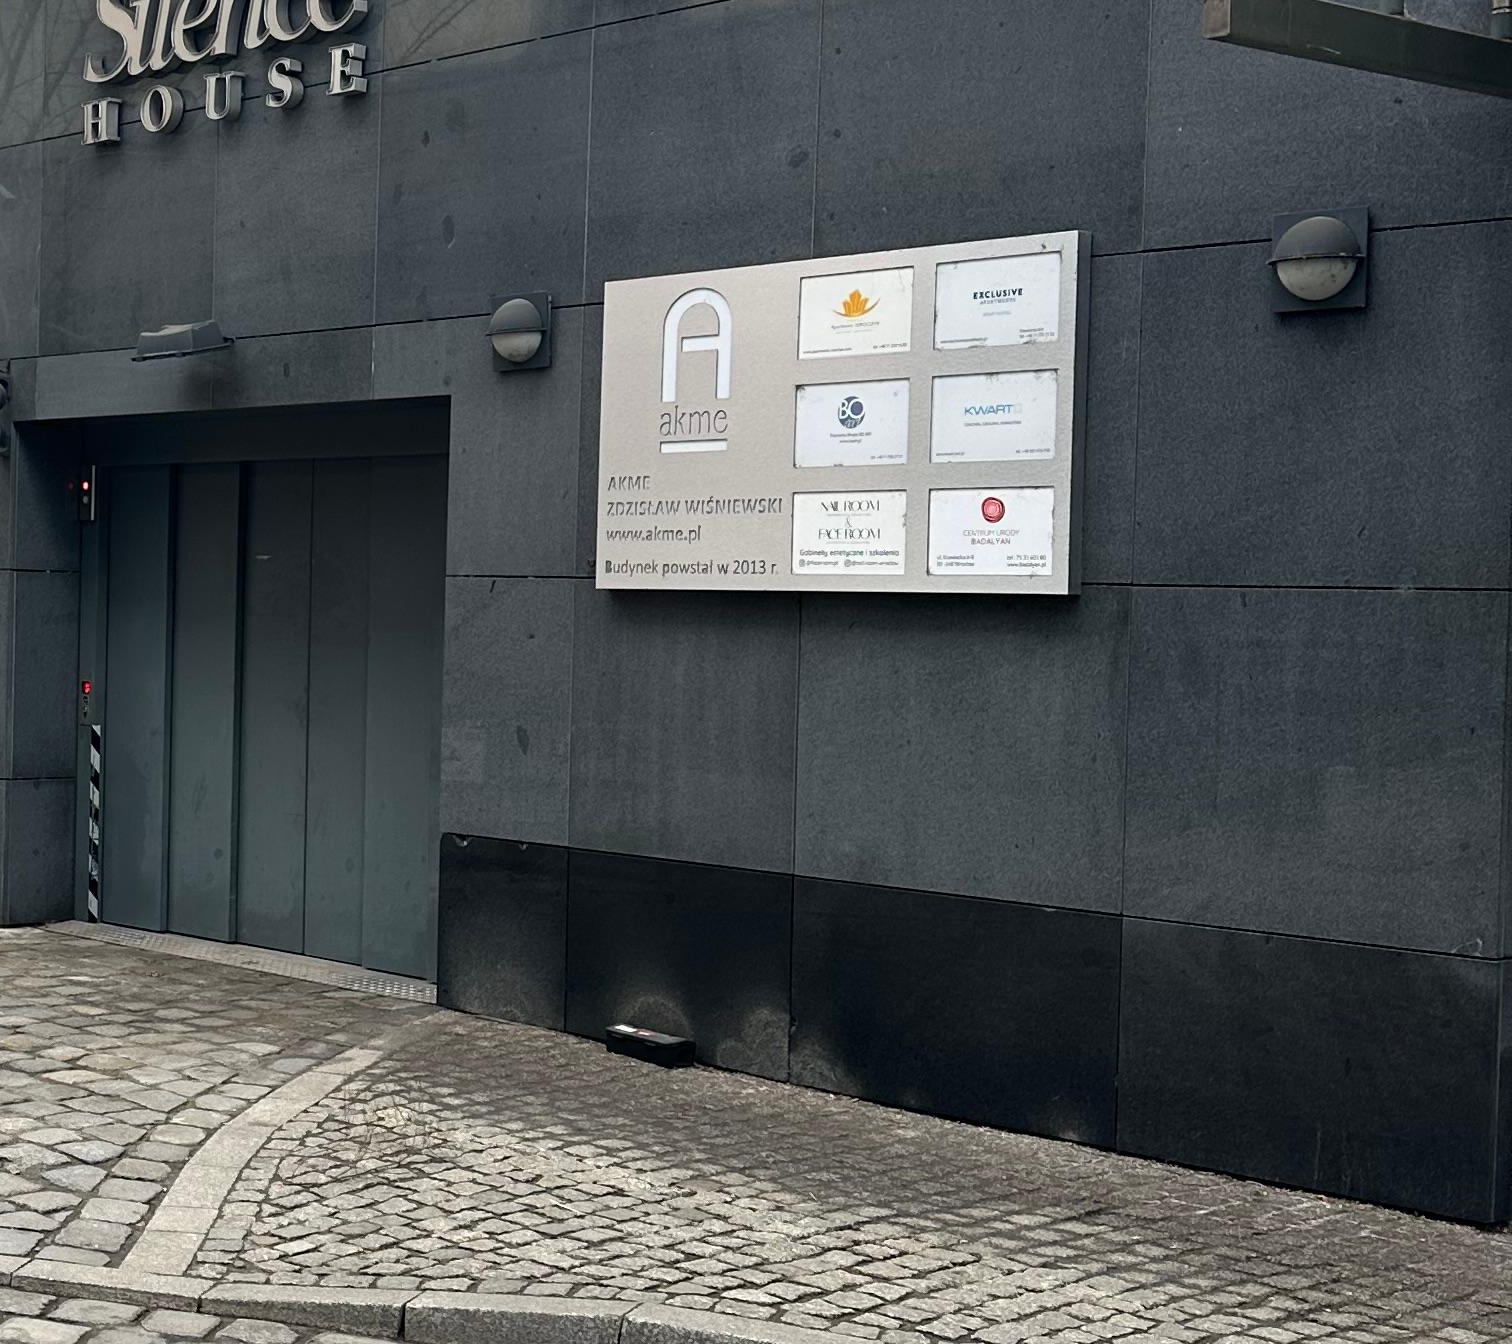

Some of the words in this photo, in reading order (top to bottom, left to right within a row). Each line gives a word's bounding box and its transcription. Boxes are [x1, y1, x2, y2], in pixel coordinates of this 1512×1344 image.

[80, 42, 368, 146] HOUSE
[973, 288, 1023, 300] EXCLUSIVE
[659, 404, 729, 437] akme
[607, 475, 651, 492] AKME
[606, 499, 680, 517] ZDZISŁAW
[684, 495, 783, 515] WIŚNIEWSKI
[843, 500, 880, 512] ROOM
[605, 524, 702, 544] www.akme.pl
[844, 528, 881, 540] ROOM
[970, 537, 1011, 545] BADALYAN
[604, 559, 659, 577] Budynek
[662, 559, 713, 577] powstał
[717, 564, 729, 575] w
[732, 560, 767, 575] 2013
[770, 563, 779, 575] r.
